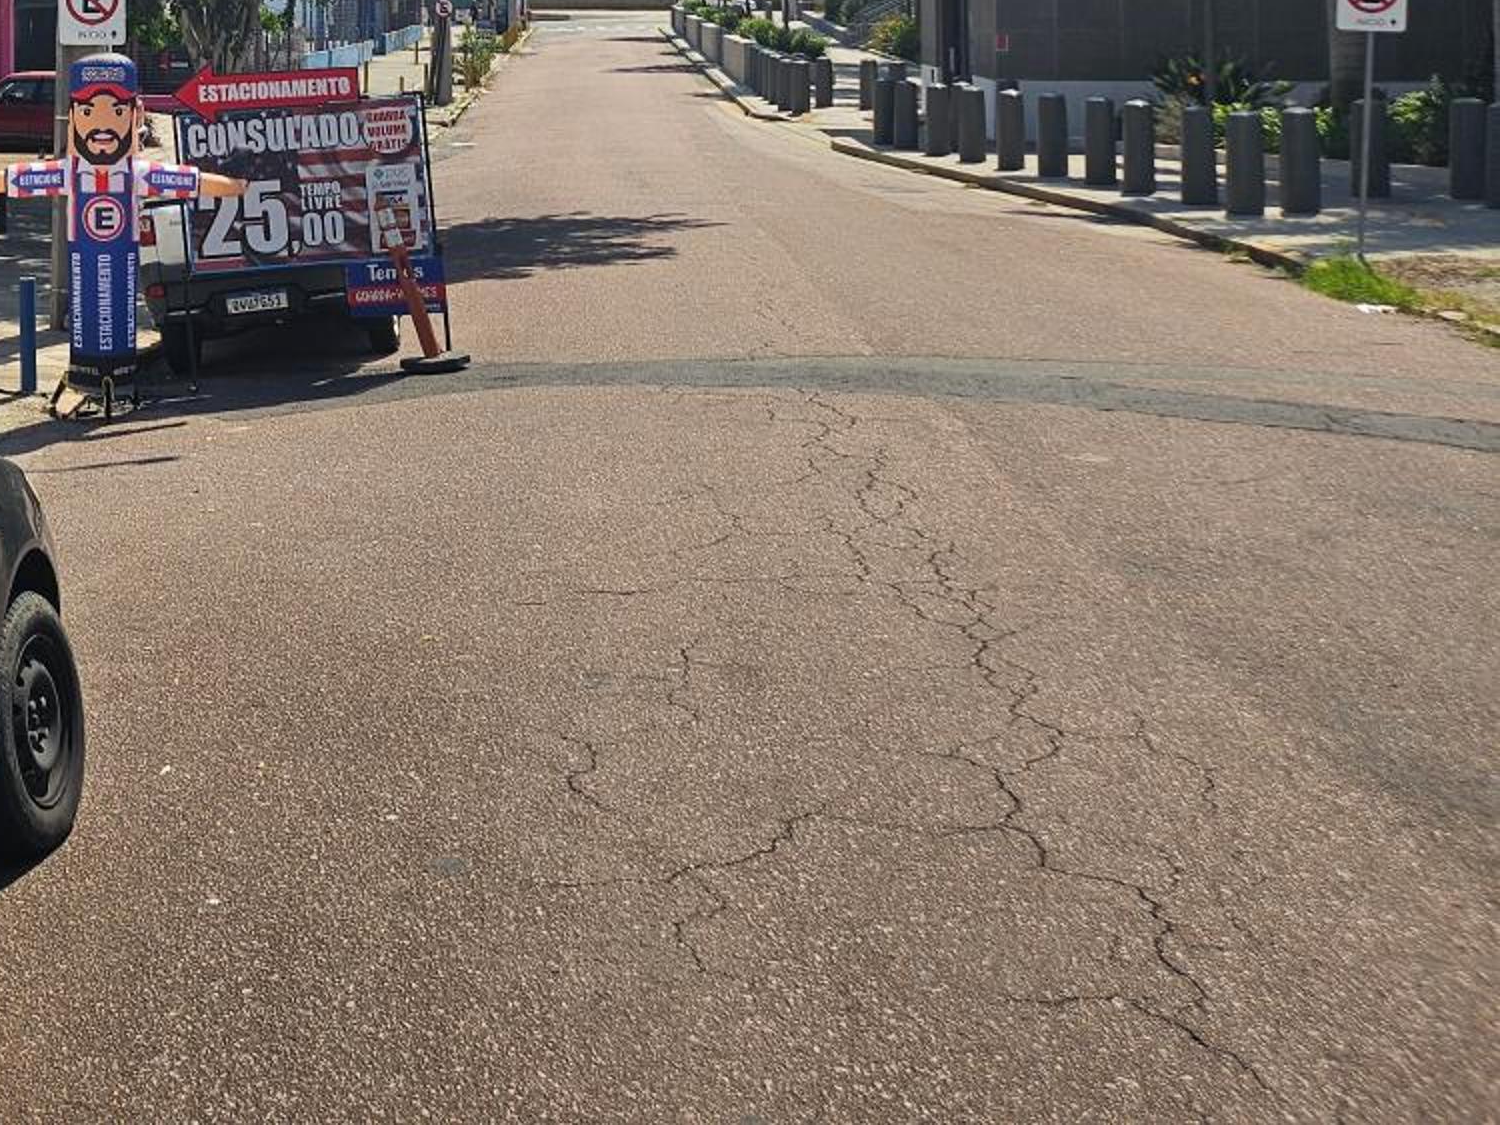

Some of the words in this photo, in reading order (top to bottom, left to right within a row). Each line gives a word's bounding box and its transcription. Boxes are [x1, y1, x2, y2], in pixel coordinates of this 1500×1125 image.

[199, 77, 351, 103] ESTACIONAMENTO
[187, 112, 361, 158] CONSULADO
[300, 181, 341, 196] TEMPO
[300, 195, 342, 209] LIVRE
[95, 207, 114, 230] E
[97, 254, 113, 350] ESTACIONAMENTO
